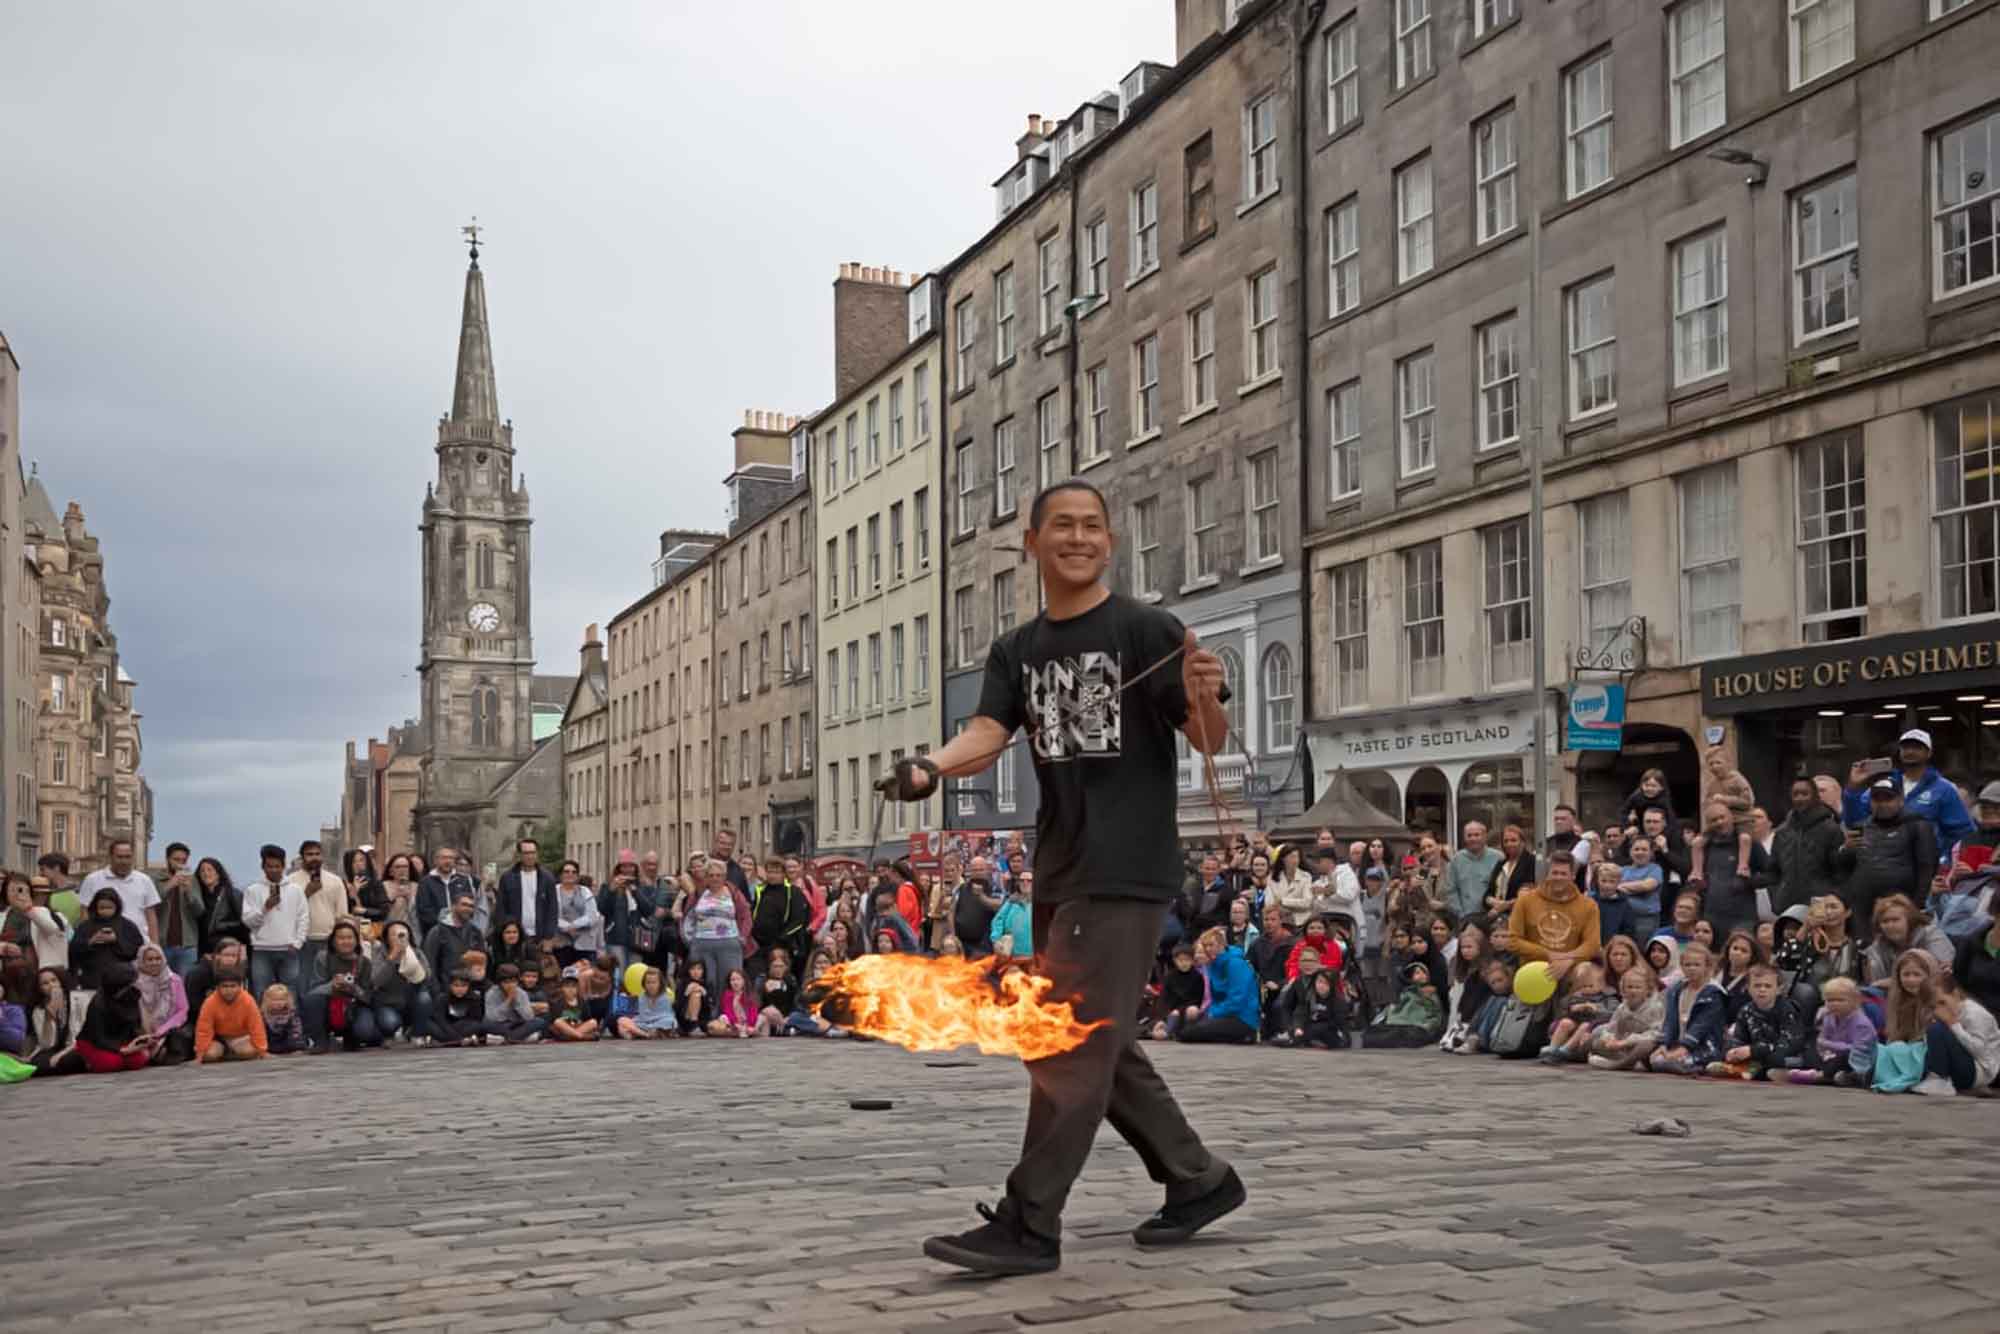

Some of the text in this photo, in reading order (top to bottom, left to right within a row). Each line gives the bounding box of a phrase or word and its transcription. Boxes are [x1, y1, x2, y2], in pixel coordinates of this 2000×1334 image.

[1713, 666, 1807, 698] HOUSE
[1813, 659, 1851, 687] OF
[1345, 726, 1509, 755] TASTE OF SCOTLAND
